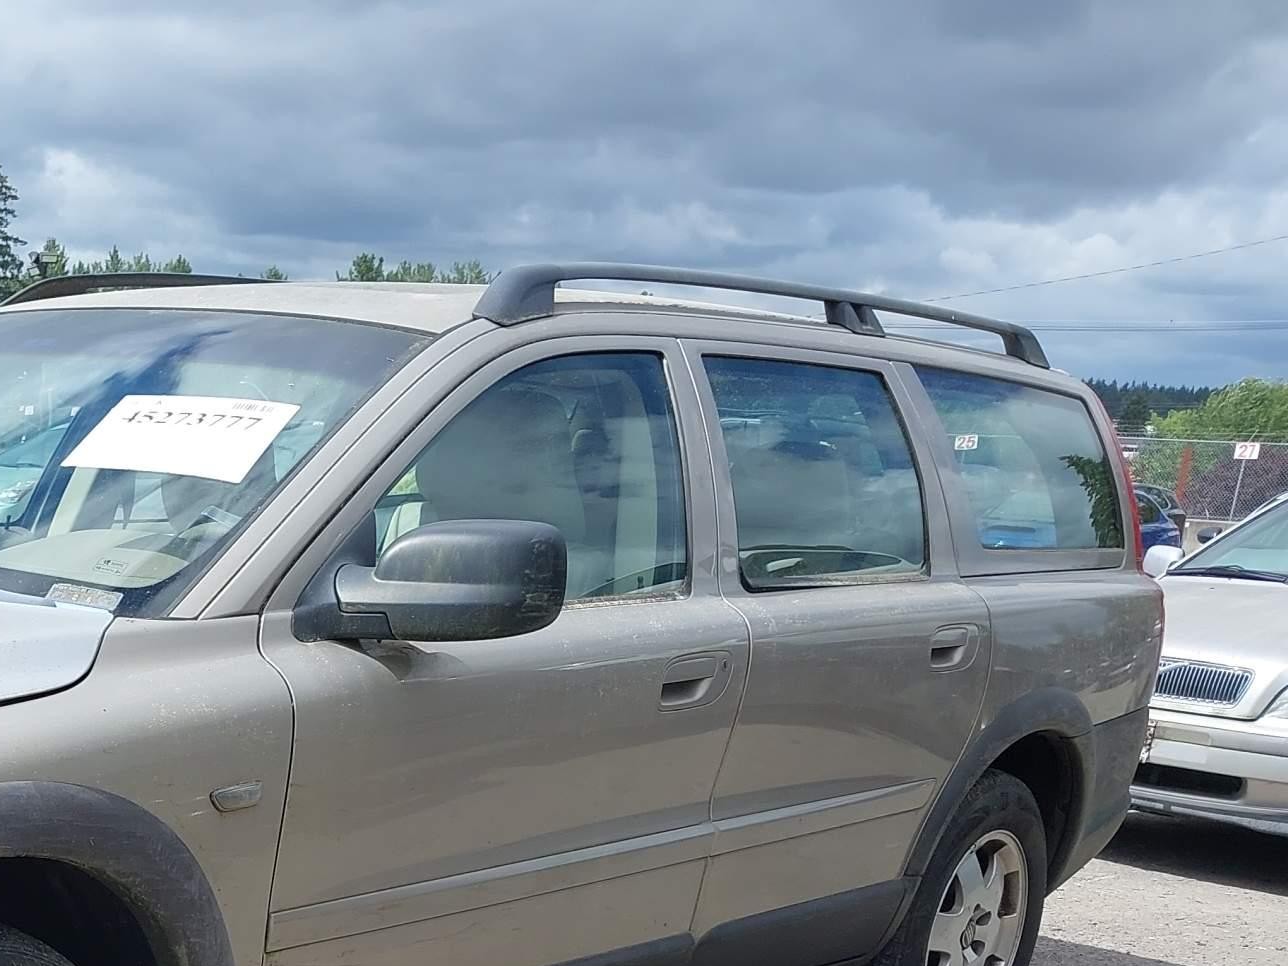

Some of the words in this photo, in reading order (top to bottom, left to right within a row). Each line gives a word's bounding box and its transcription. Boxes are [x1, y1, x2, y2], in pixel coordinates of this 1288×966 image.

[122, 410, 263, 431] 45273777
[957, 436, 976, 449] 25
[1238, 444, 1256, 458] 27
